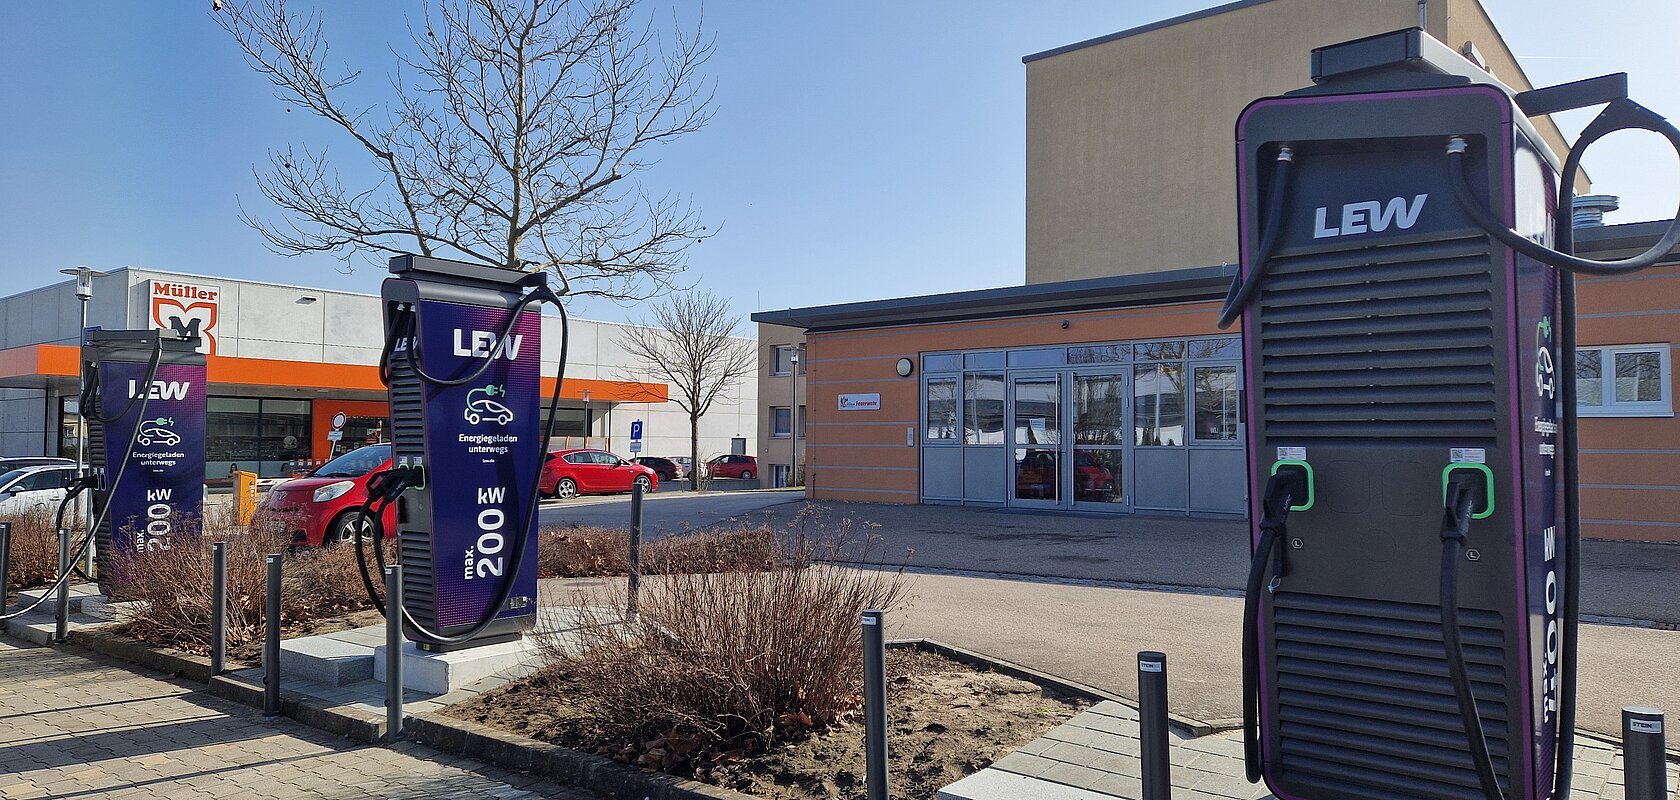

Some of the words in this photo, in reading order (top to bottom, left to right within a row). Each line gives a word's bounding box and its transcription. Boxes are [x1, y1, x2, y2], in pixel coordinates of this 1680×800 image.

[1313, 193, 1428, 239] LEW
[153, 282, 218, 300] Müller
[453, 328, 523, 360] LEW
[128, 379, 190, 400] LEW
[458, 433, 518, 444] Energiegeladen
[632, 423, 640, 438] P
[132, 451, 185, 459] Energiegeladen
[468, 445, 508, 455] unterwegs
[147, 488, 172, 501] kW
[477, 487, 506, 504] kW
[476, 508, 505, 578] 200
[464, 545, 475, 580] max.
[1545, 570, 1559, 712] 400
